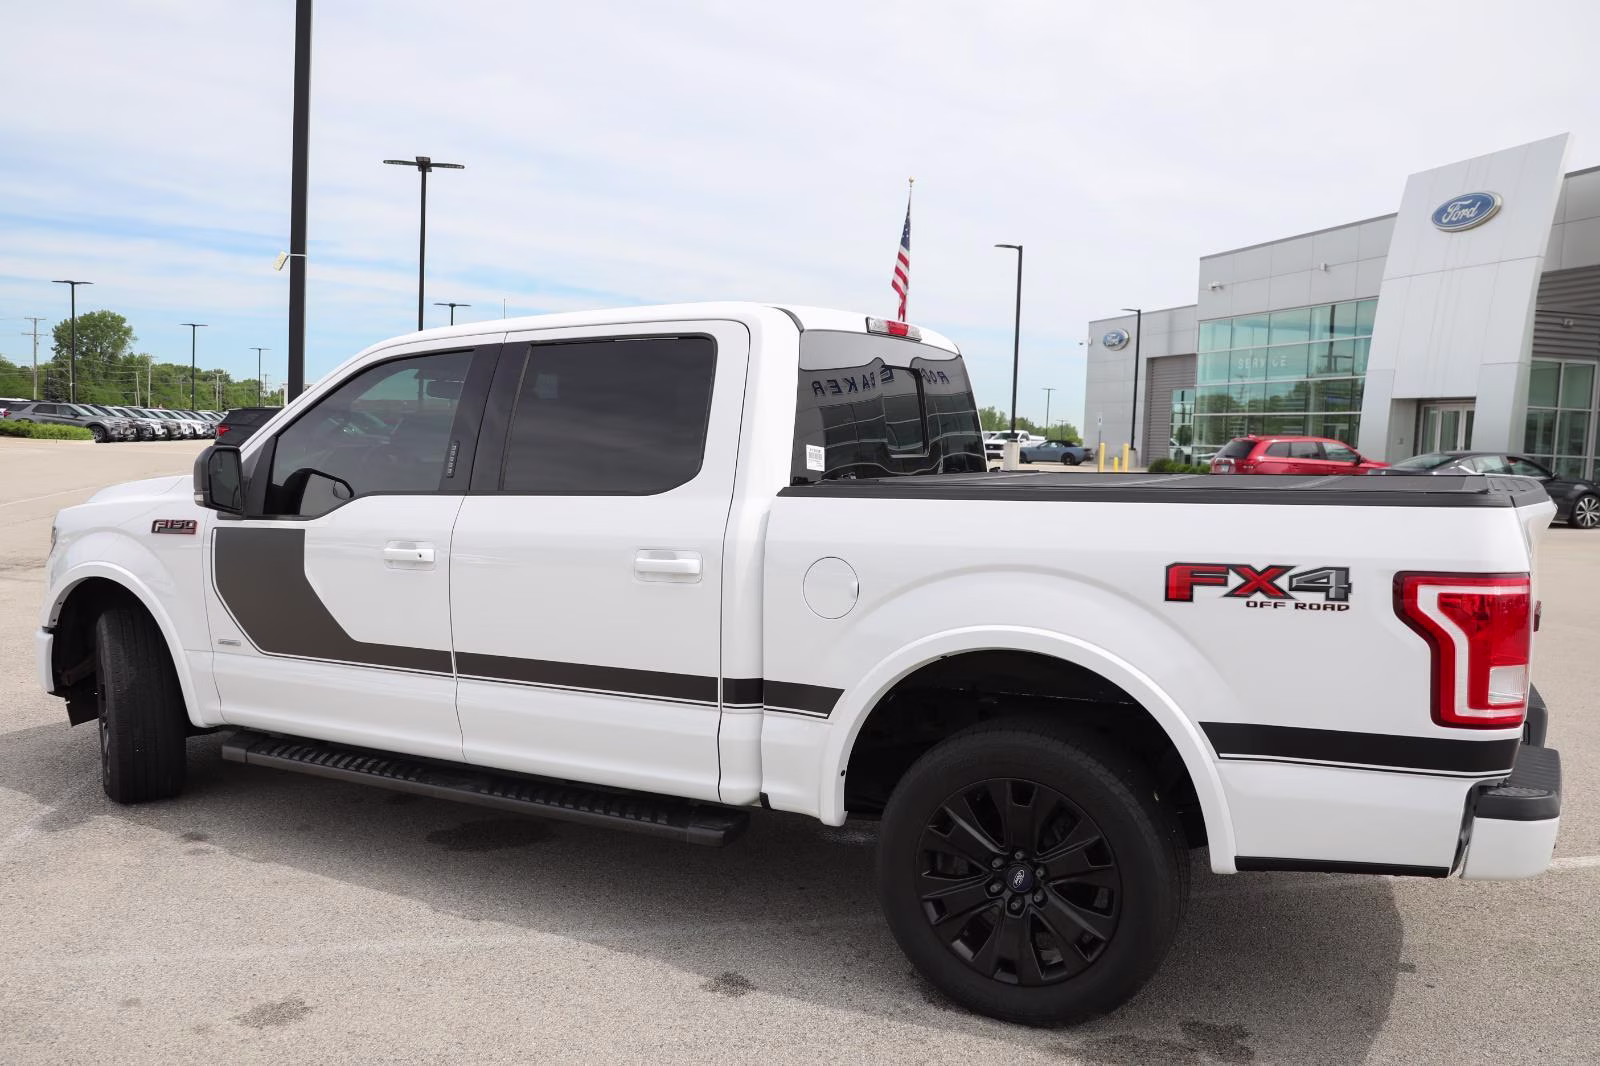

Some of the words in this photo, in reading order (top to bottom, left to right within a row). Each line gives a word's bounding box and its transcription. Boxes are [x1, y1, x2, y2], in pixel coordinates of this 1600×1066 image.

[1441, 199, 1481, 223] Ford
[1238, 355, 1288, 369] SERVCE
[1164, 562, 1352, 602] FX4
[1245, 600, 1287, 609] OFF
[1294, 601, 1351, 612] ROAD
